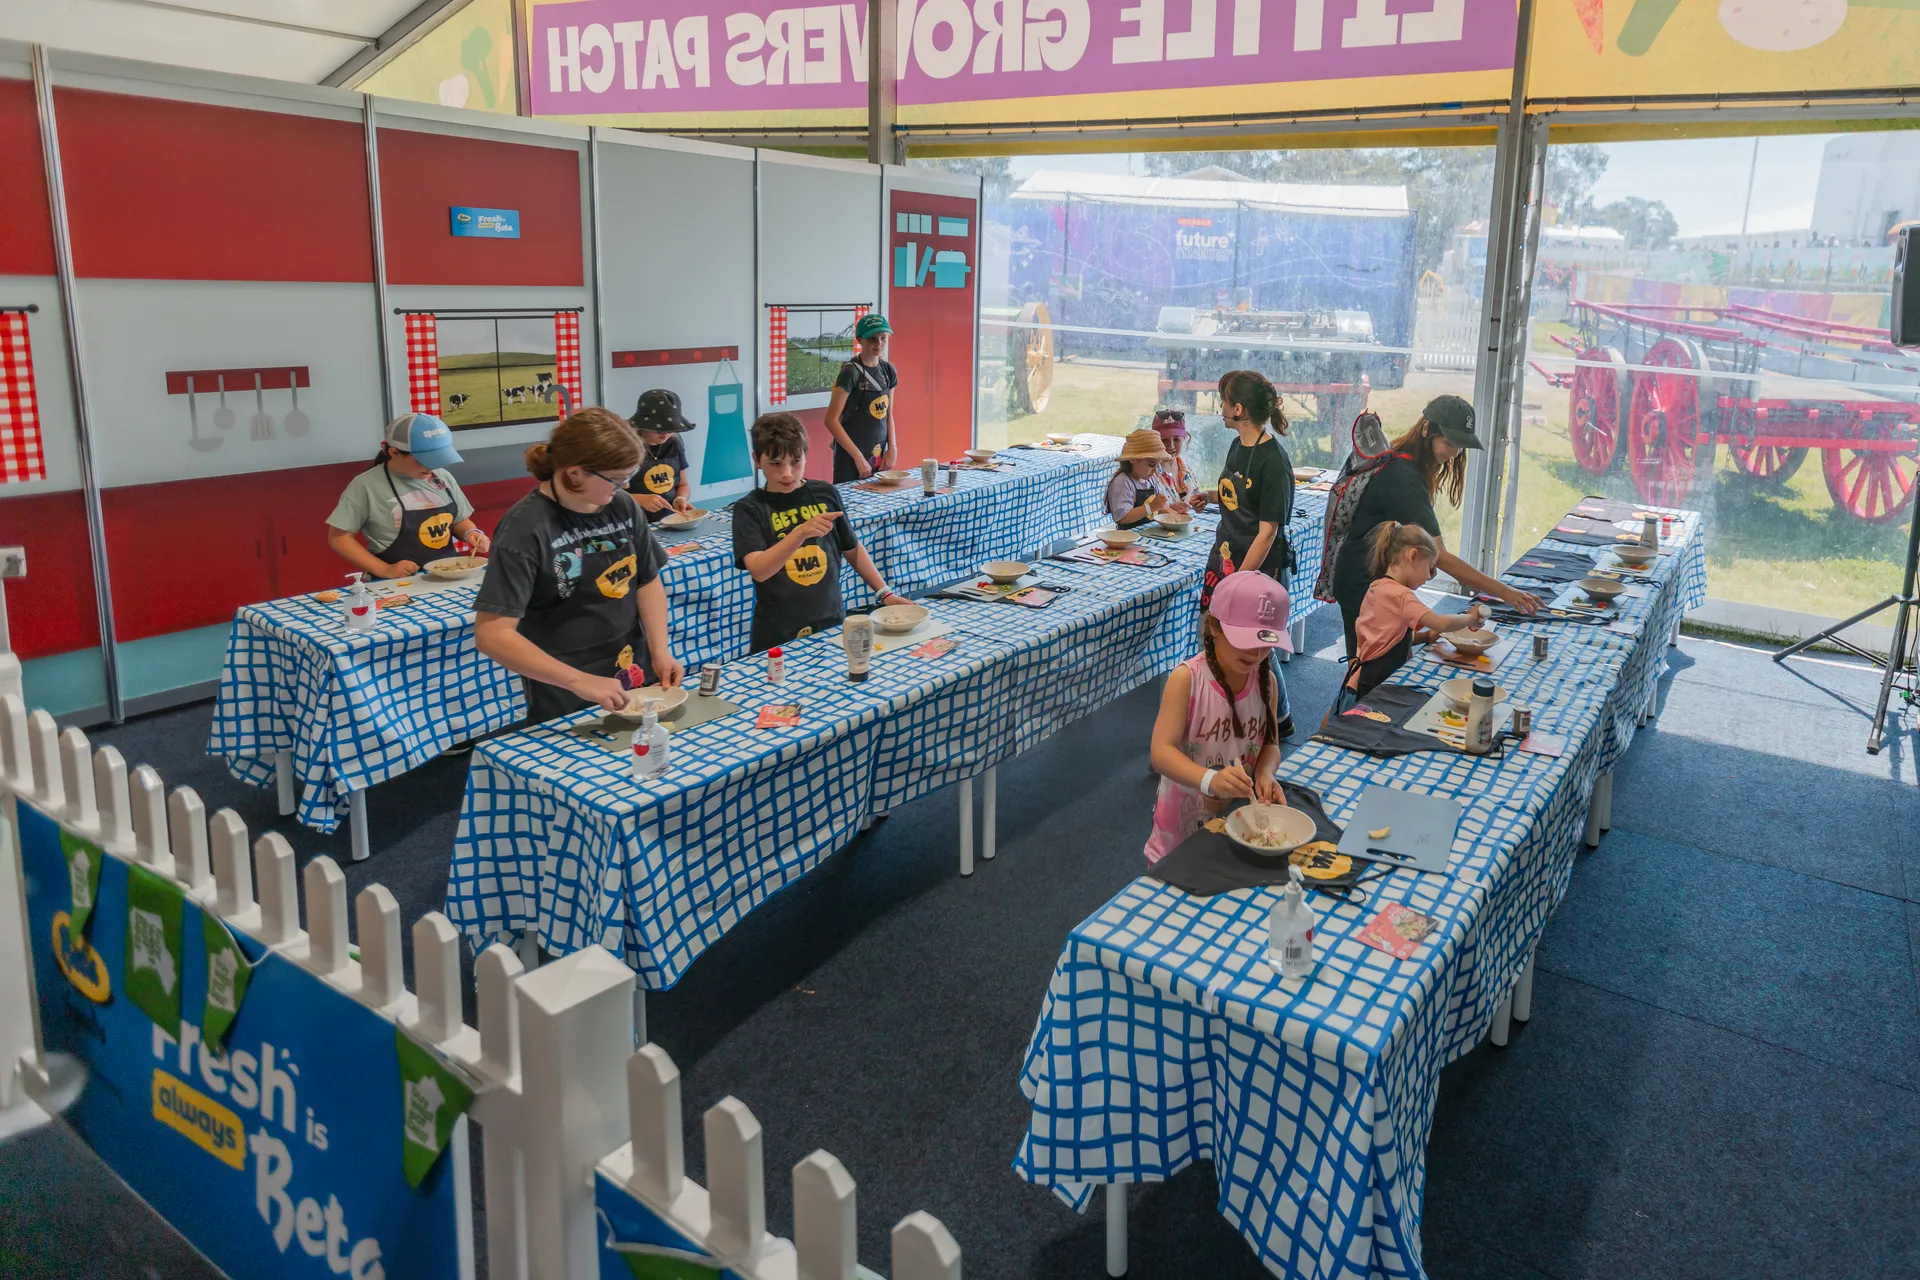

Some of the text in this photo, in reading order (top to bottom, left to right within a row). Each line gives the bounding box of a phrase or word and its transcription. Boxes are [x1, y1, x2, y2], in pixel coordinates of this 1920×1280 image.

[1176, 230, 1229, 248] future
[650, 471, 670, 484] WA
[771, 503, 828, 532] GET OUT
[794, 556, 820, 572] WA
[159, 1085, 236, 1150] always
[306, 1105, 329, 1151] is
